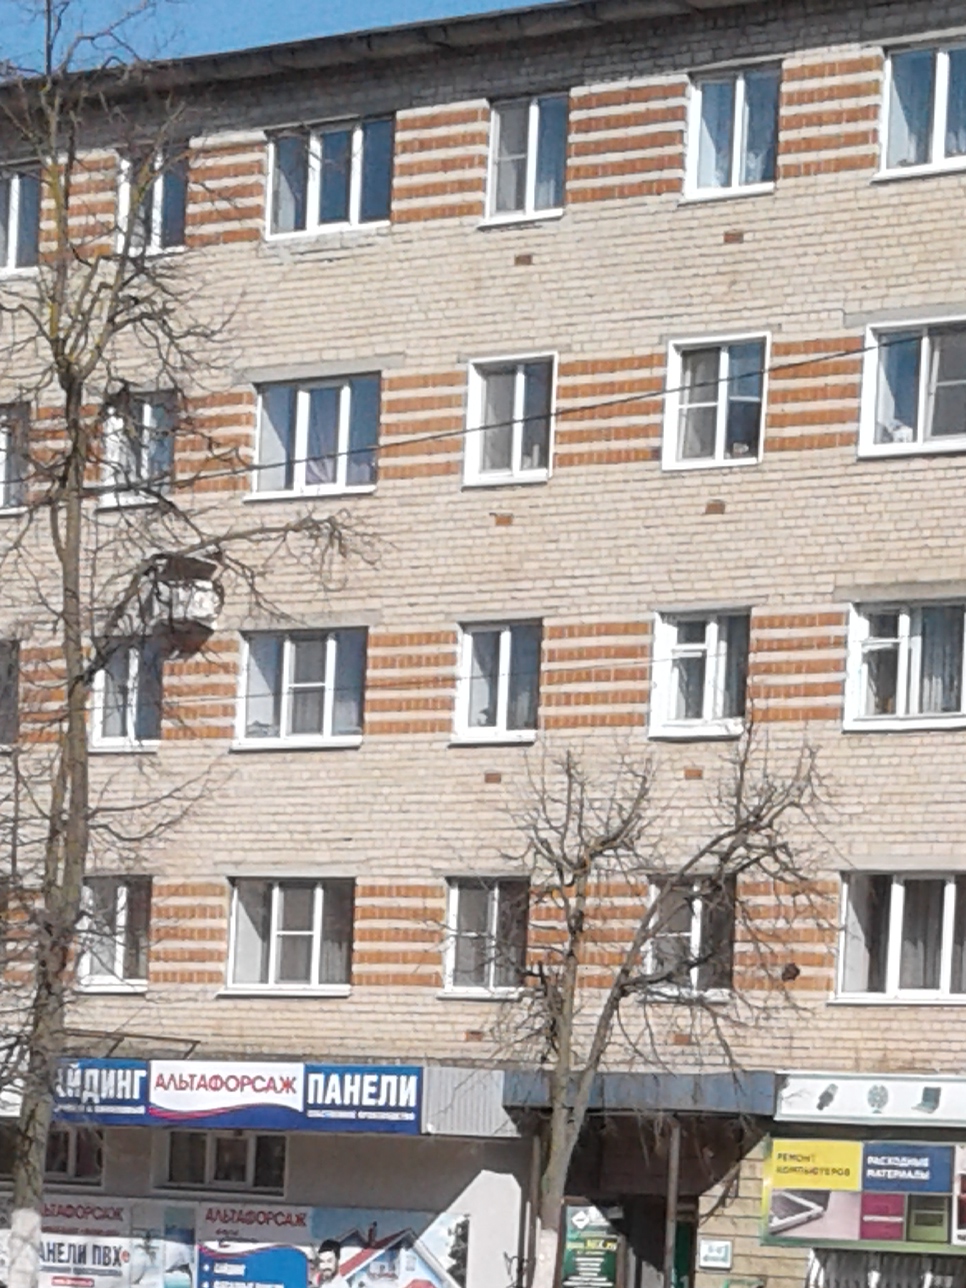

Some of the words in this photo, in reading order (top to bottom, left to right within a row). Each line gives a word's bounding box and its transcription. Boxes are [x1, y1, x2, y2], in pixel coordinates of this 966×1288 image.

[154, 1072, 297, 1095] АЛЬТАФОРСАЖ
[307, 1072, 418, 1107] ПАНЕЛИ
[205, 1207, 308, 1227] АЛЬТАФОРСАЖ
